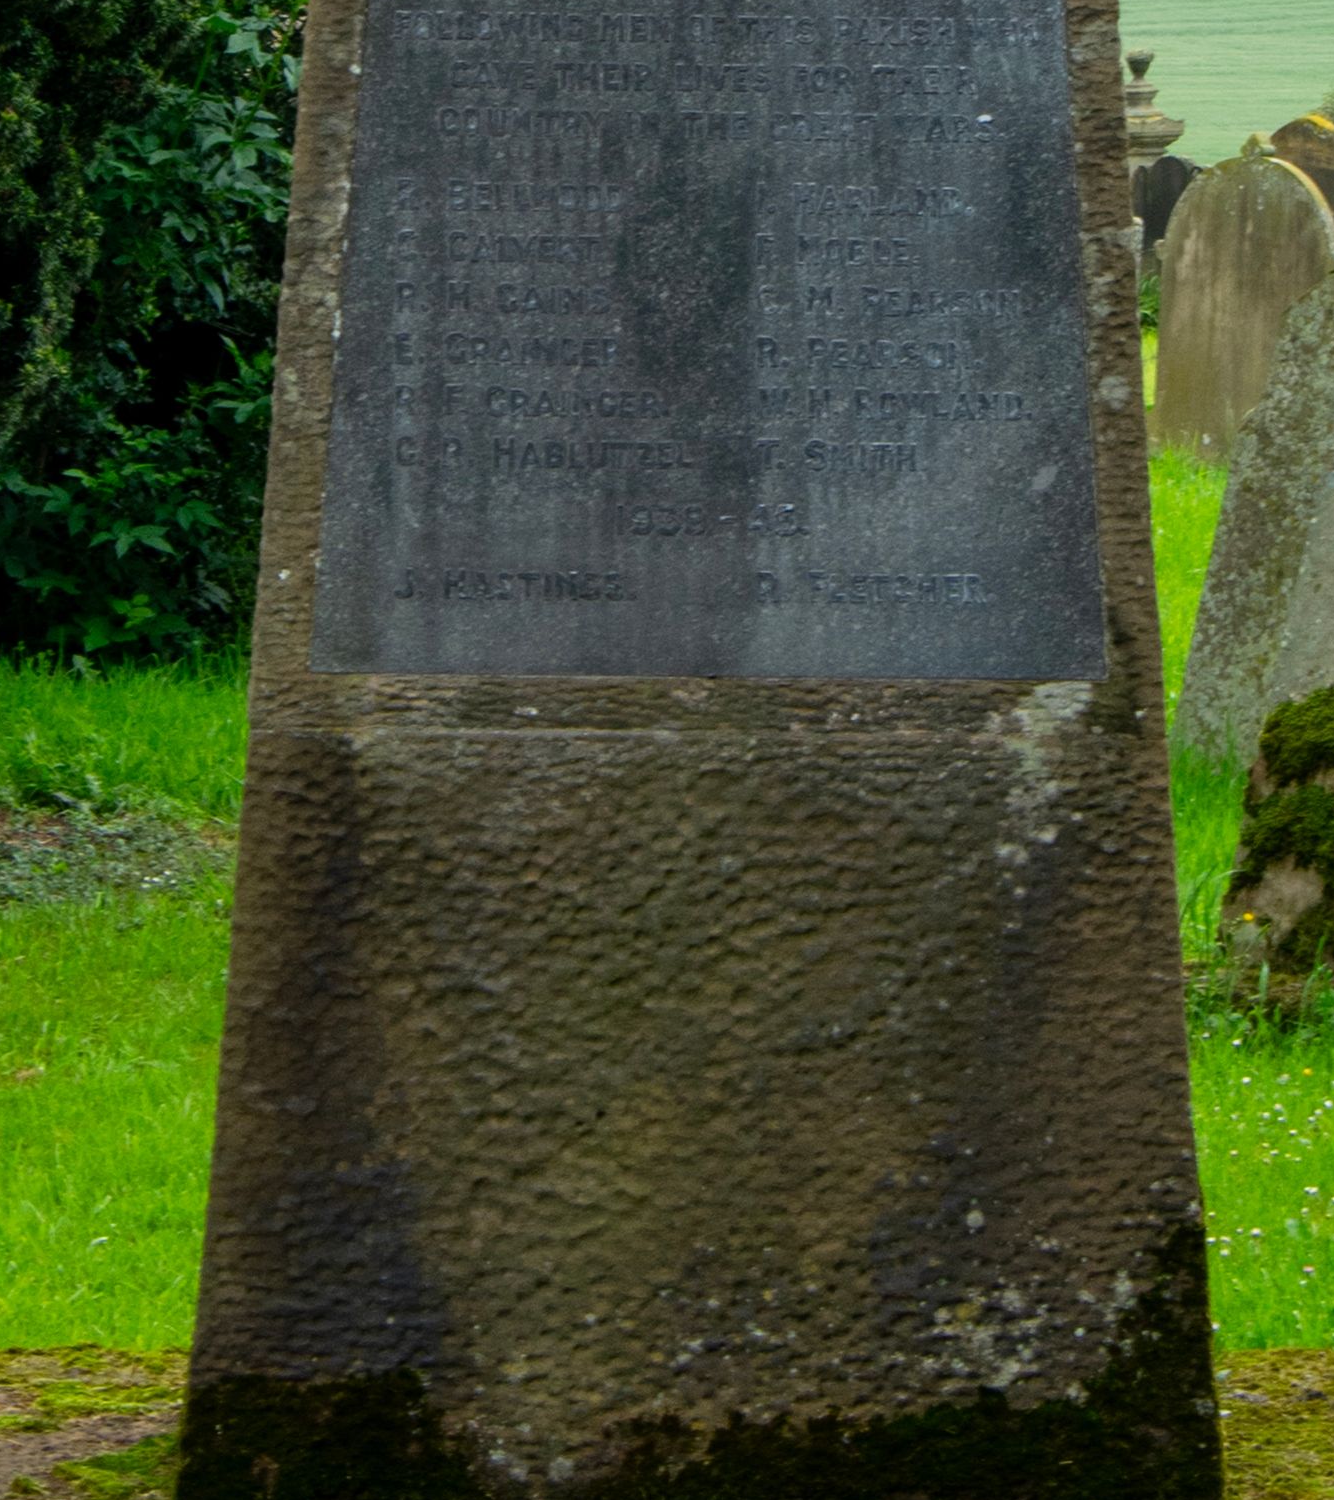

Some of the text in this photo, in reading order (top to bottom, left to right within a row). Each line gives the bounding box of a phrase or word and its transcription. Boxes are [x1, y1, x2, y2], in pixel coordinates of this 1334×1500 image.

[392, 9, 588, 43] FOLLOWING
[599, 11, 673, 44] MEN
[688, 13, 726, 45] OF
[736, 13, 818, 47] THIS
[833, 15, 957, 48] PARISH
[449, 60, 979, 96] GAVE THEIR LIVES FOR THEIR
[436, 107, 610, 139] COUNTRY
[678, 110, 752, 140] THE
[769, 111, 878, 142] GREAT
